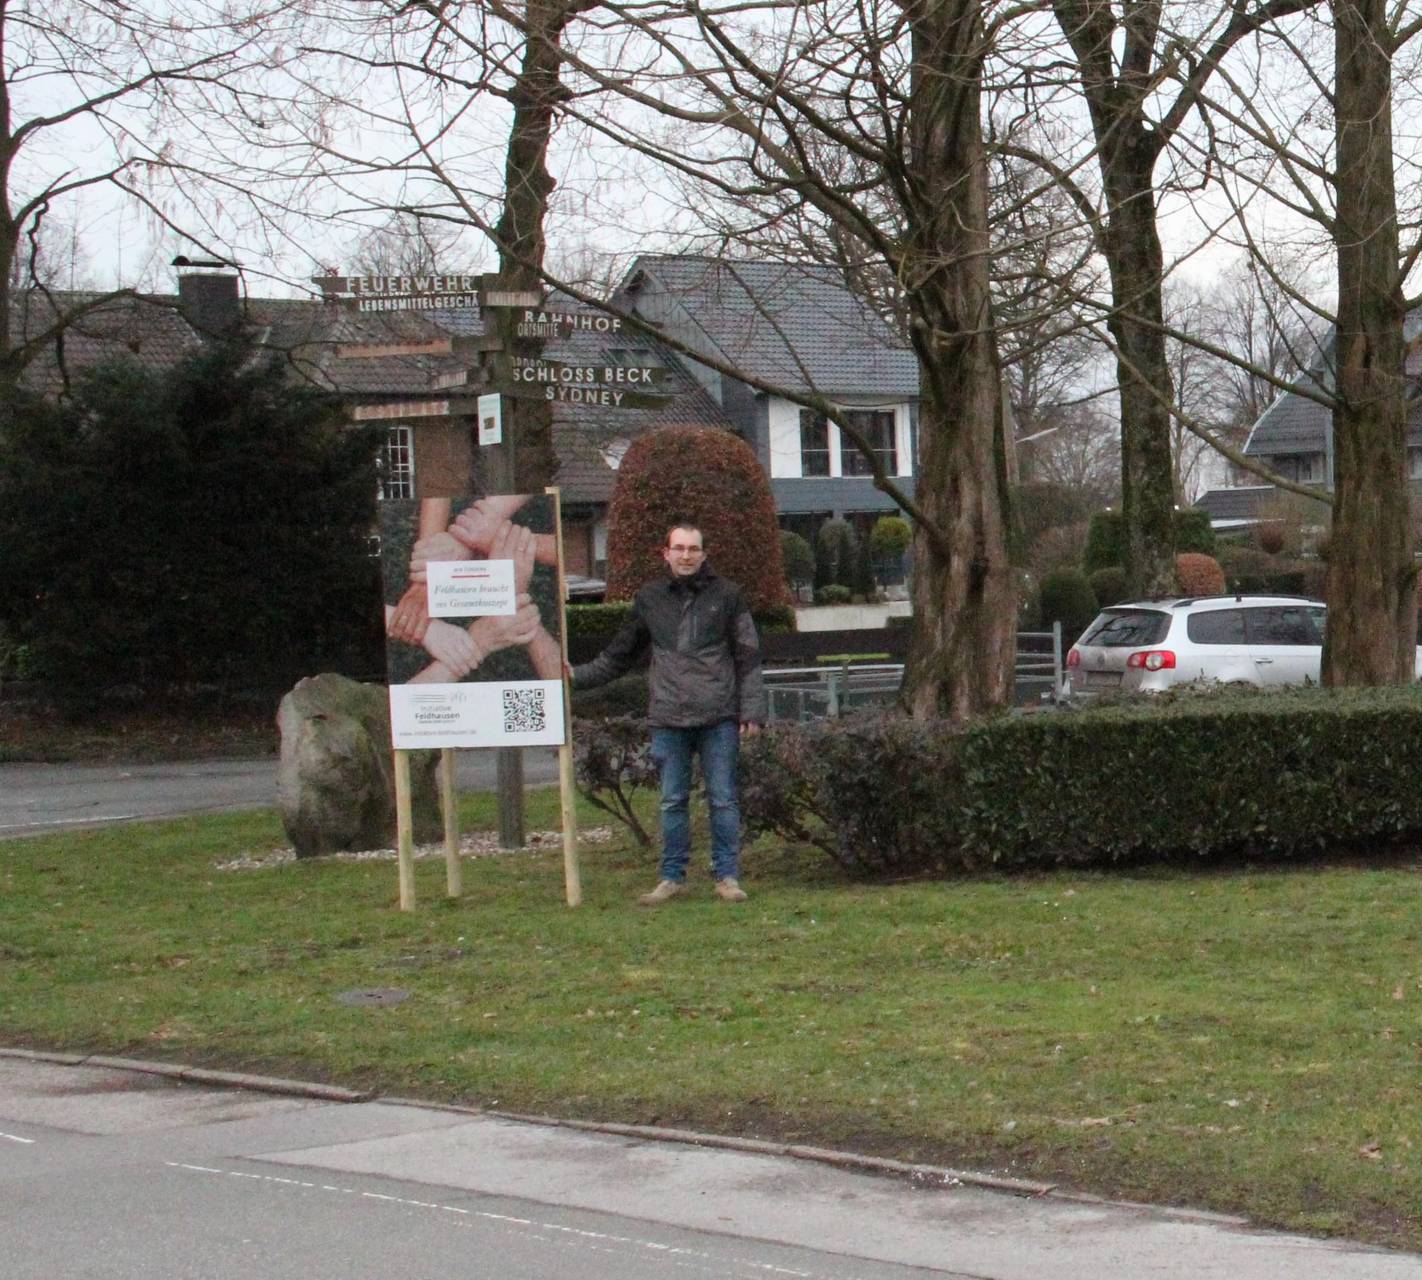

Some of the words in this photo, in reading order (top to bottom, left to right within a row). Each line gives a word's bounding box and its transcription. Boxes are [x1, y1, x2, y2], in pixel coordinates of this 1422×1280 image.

[346, 276, 472, 293] FEUERWEHR
[517, 322, 559, 337] ORTSMITTE
[513, 367, 594, 382] SCHLOSS
[605, 367, 652, 382] BECK
[545, 386, 623, 406] SYDNEY
[415, 712, 461, 720] Feldhausen
